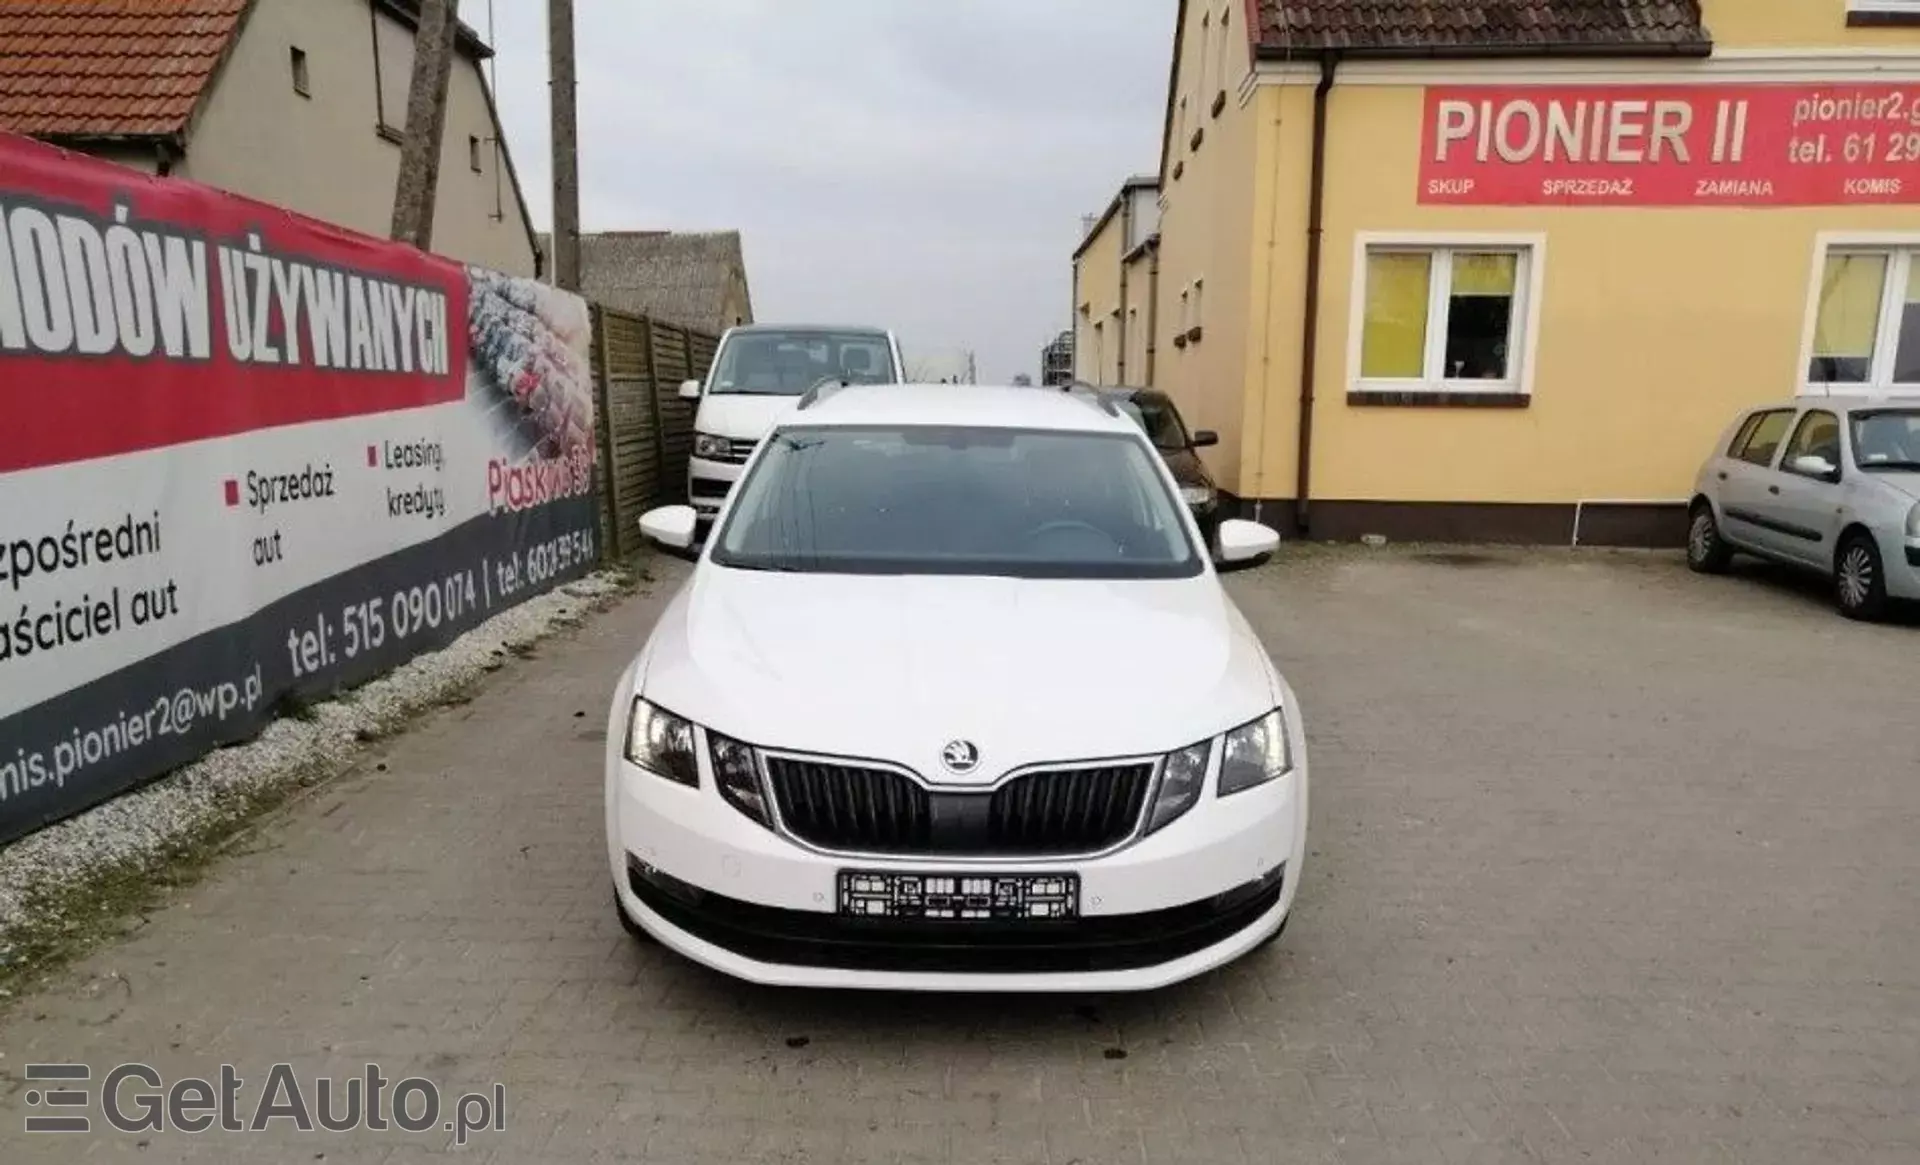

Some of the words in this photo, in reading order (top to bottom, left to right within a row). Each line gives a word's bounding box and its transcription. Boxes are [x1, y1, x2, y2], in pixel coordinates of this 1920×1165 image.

[1434, 98, 1693, 164] PIONIER
[1711, 99, 1749, 164] II
[1788, 132, 1832, 164] tel.
[1843, 132, 1876, 163] 61
[1885, 132, 1920, 162] 29
[1427, 178, 1474, 195] SKUP
[1542, 177, 1633, 196] SPRZEDAŻ
[1695, 179, 1773, 196] ZAMIANA
[1843, 178, 1902, 194] KOMIS
[218, 232, 449, 375] UŻYWANYCH
[246, 463, 335, 515] Sprzedaż
[253, 529, 283, 566] aut
[131, 579, 178, 625] aut
[287, 612, 336, 677] tel:
[342, 597, 385, 658] 515
[391, 581, 442, 640] 090
[446, 569, 477, 621] 074
